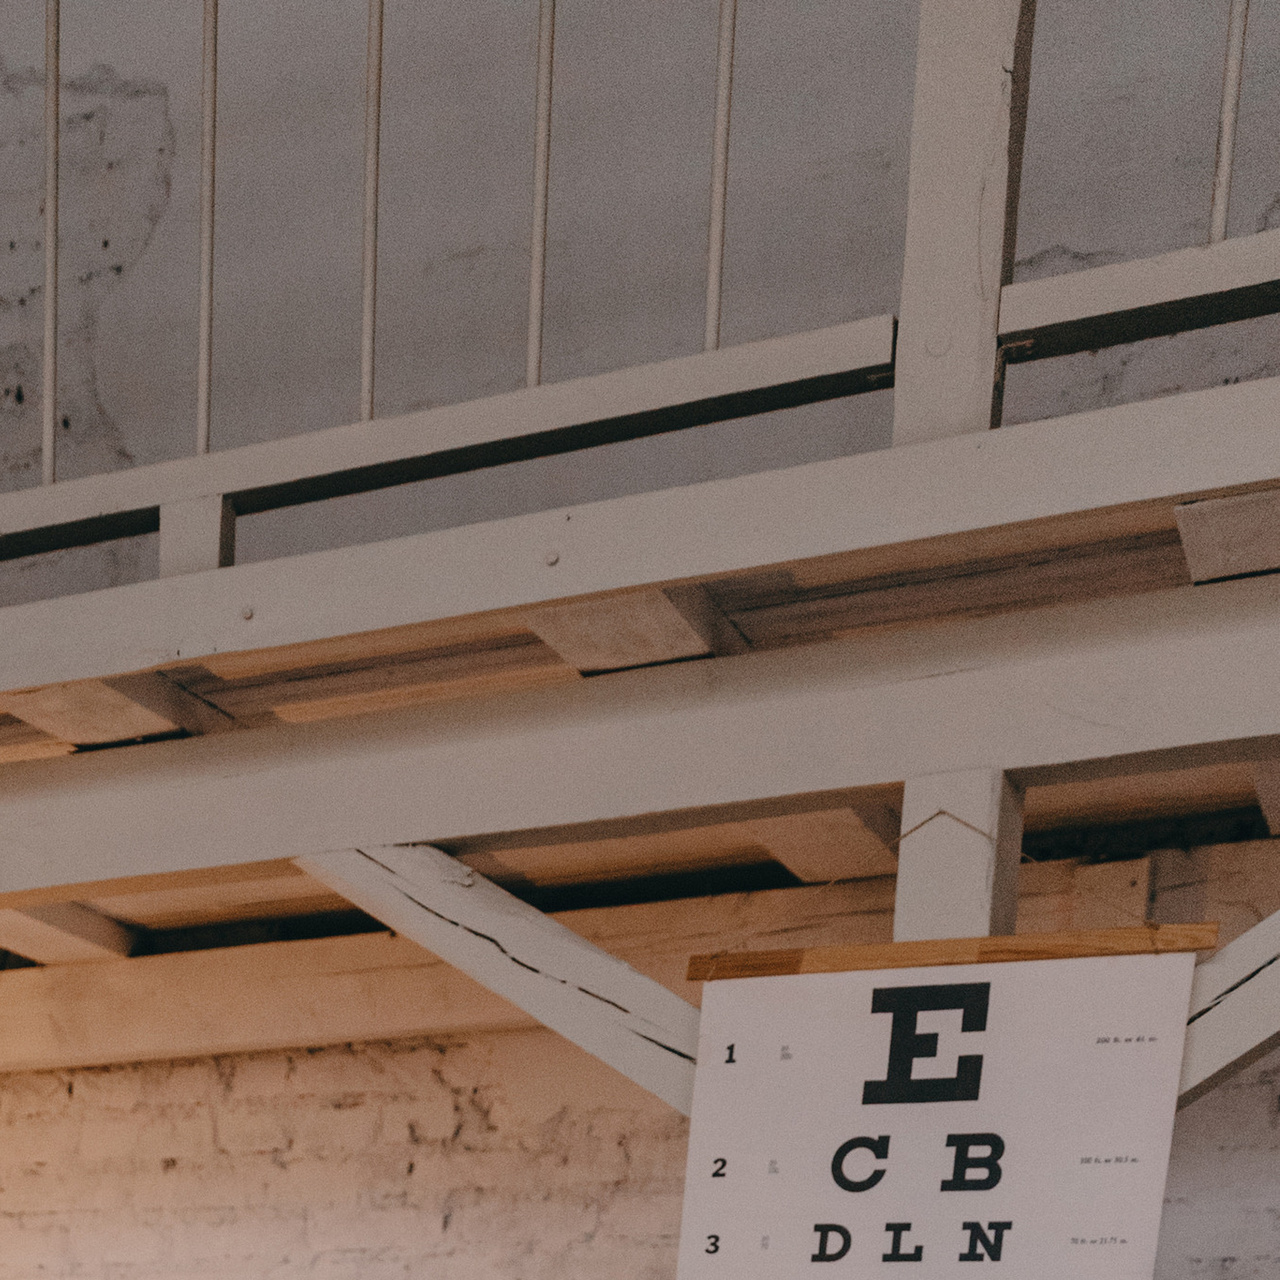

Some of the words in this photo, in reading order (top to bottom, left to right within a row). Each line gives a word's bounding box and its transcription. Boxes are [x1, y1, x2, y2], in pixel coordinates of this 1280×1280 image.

[725, 1043, 736, 1064] 1
[861, 981, 991, 1106] E
[711, 1157, 727, 1178] 2
[830, 1135, 891, 1193] C
[940, 1132, 1006, 1192] B
[705, 1234, 720, 1255] 3
